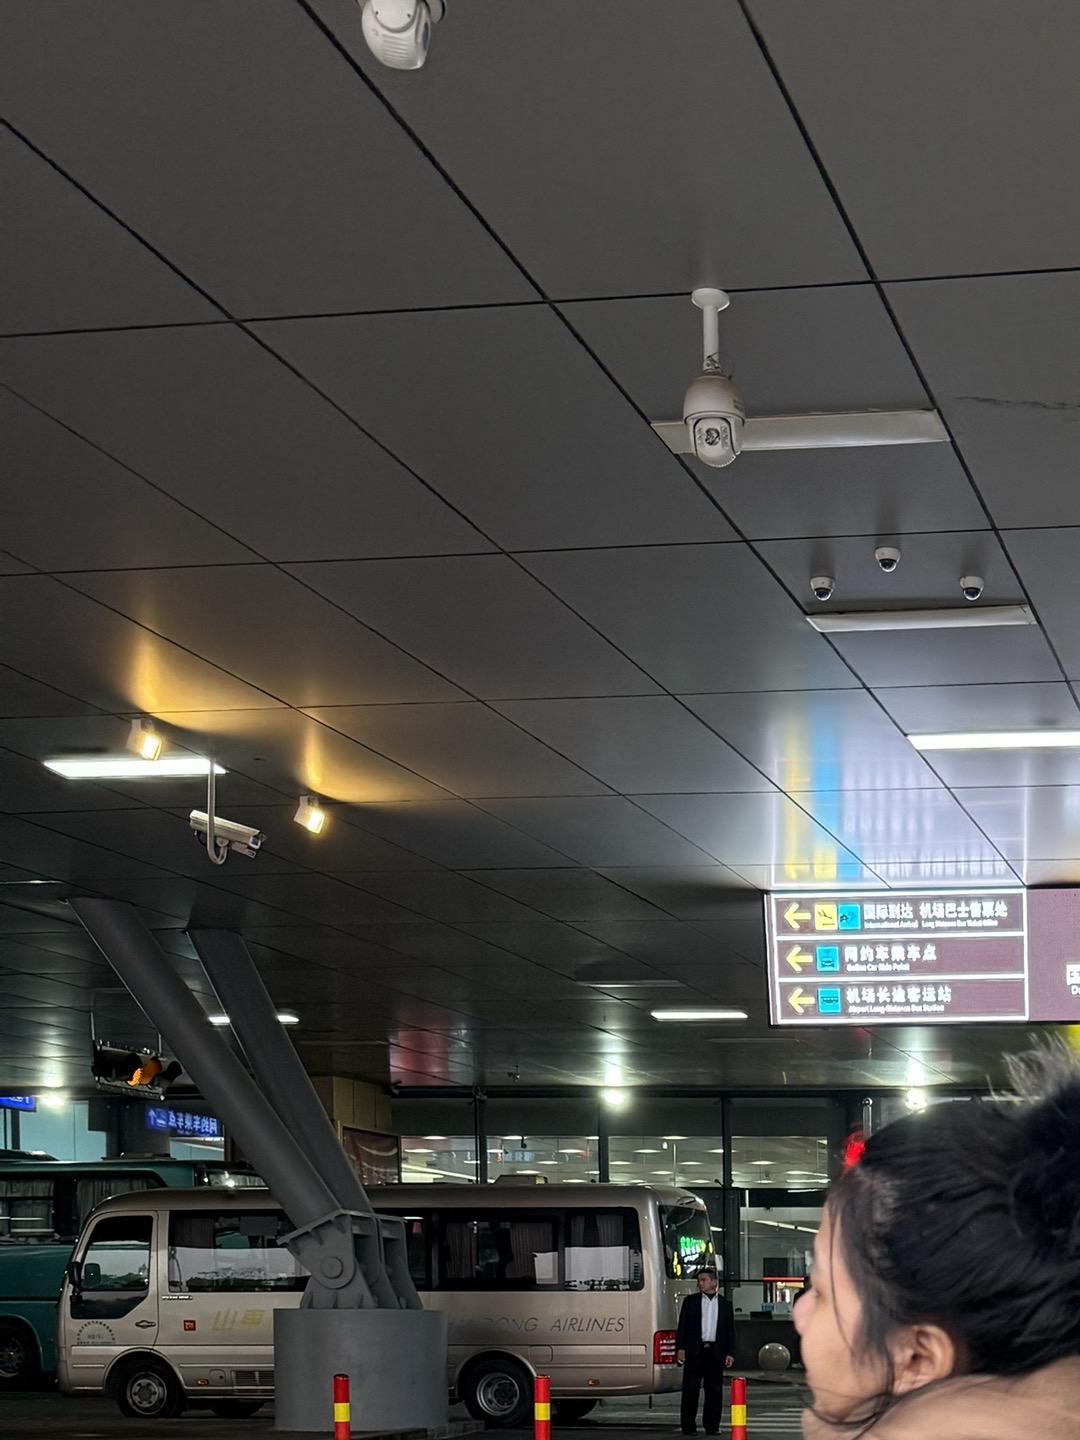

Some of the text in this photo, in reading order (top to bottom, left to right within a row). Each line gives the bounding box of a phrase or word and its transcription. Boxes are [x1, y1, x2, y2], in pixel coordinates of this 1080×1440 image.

[863, 900, 1008, 920] 国际到达 机场巴士售票处
[844, 943, 937, 962] 网约车乘车点
[846, 984, 952, 1004] 机场长途客运站
[550, 1316, 626, 1333] AIRLINES
